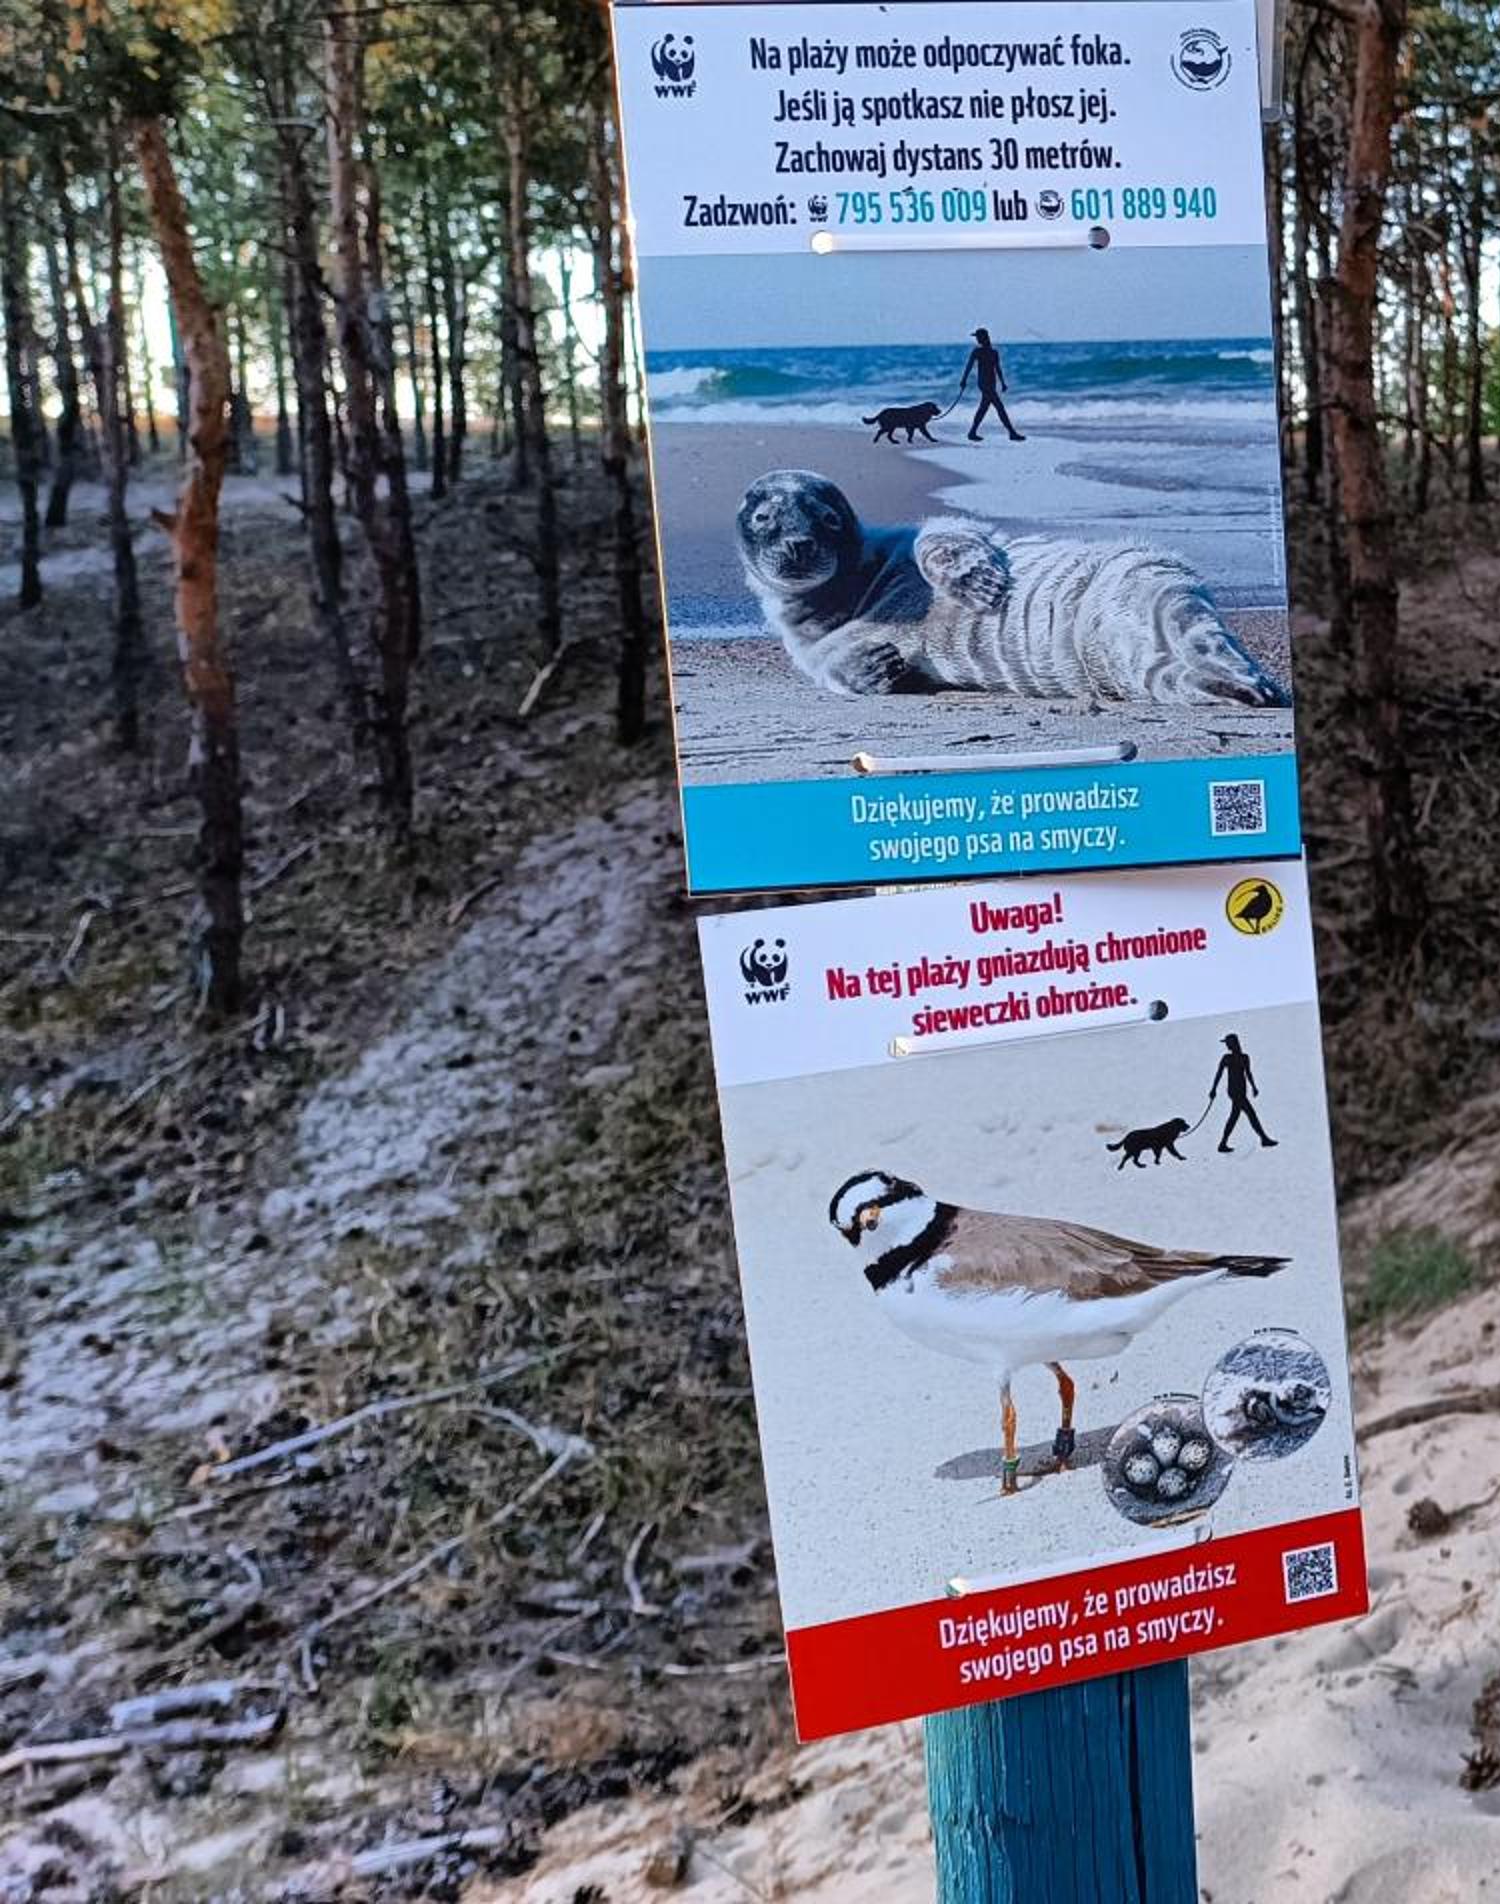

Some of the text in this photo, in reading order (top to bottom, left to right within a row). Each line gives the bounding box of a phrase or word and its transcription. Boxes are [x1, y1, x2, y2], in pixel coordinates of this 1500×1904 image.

[750, 34, 1132, 75] Na plaży może odpoczywać foka.
[655, 84, 697, 98] WWF
[774, 86, 1117, 126] Jeśli ją spotkasz nie płosz jej.
[775, 138, 1122, 178] Zachowaj dystans 30 metrów.
[683, 186, 1217, 227] Zadzwoń: 795 536 009 lub 601 889 940
[851, 782, 1139, 825] Dziękujemy, że prowadzisz
[868, 825, 1126, 862] swojego psa na smyczy.
[970, 892, 1063, 935] Uwaga!
[826, 926, 1207, 1000] Na tej plaży gniazdują chronione
[746, 985, 790, 1005] WWF
[912, 981, 1138, 1036] sieweczki obrożne.
[939, 1562, 1237, 1649] Dziękujemy, że prowadzisz
[960, 1607, 1225, 1684] swojego psa na smyczy.
